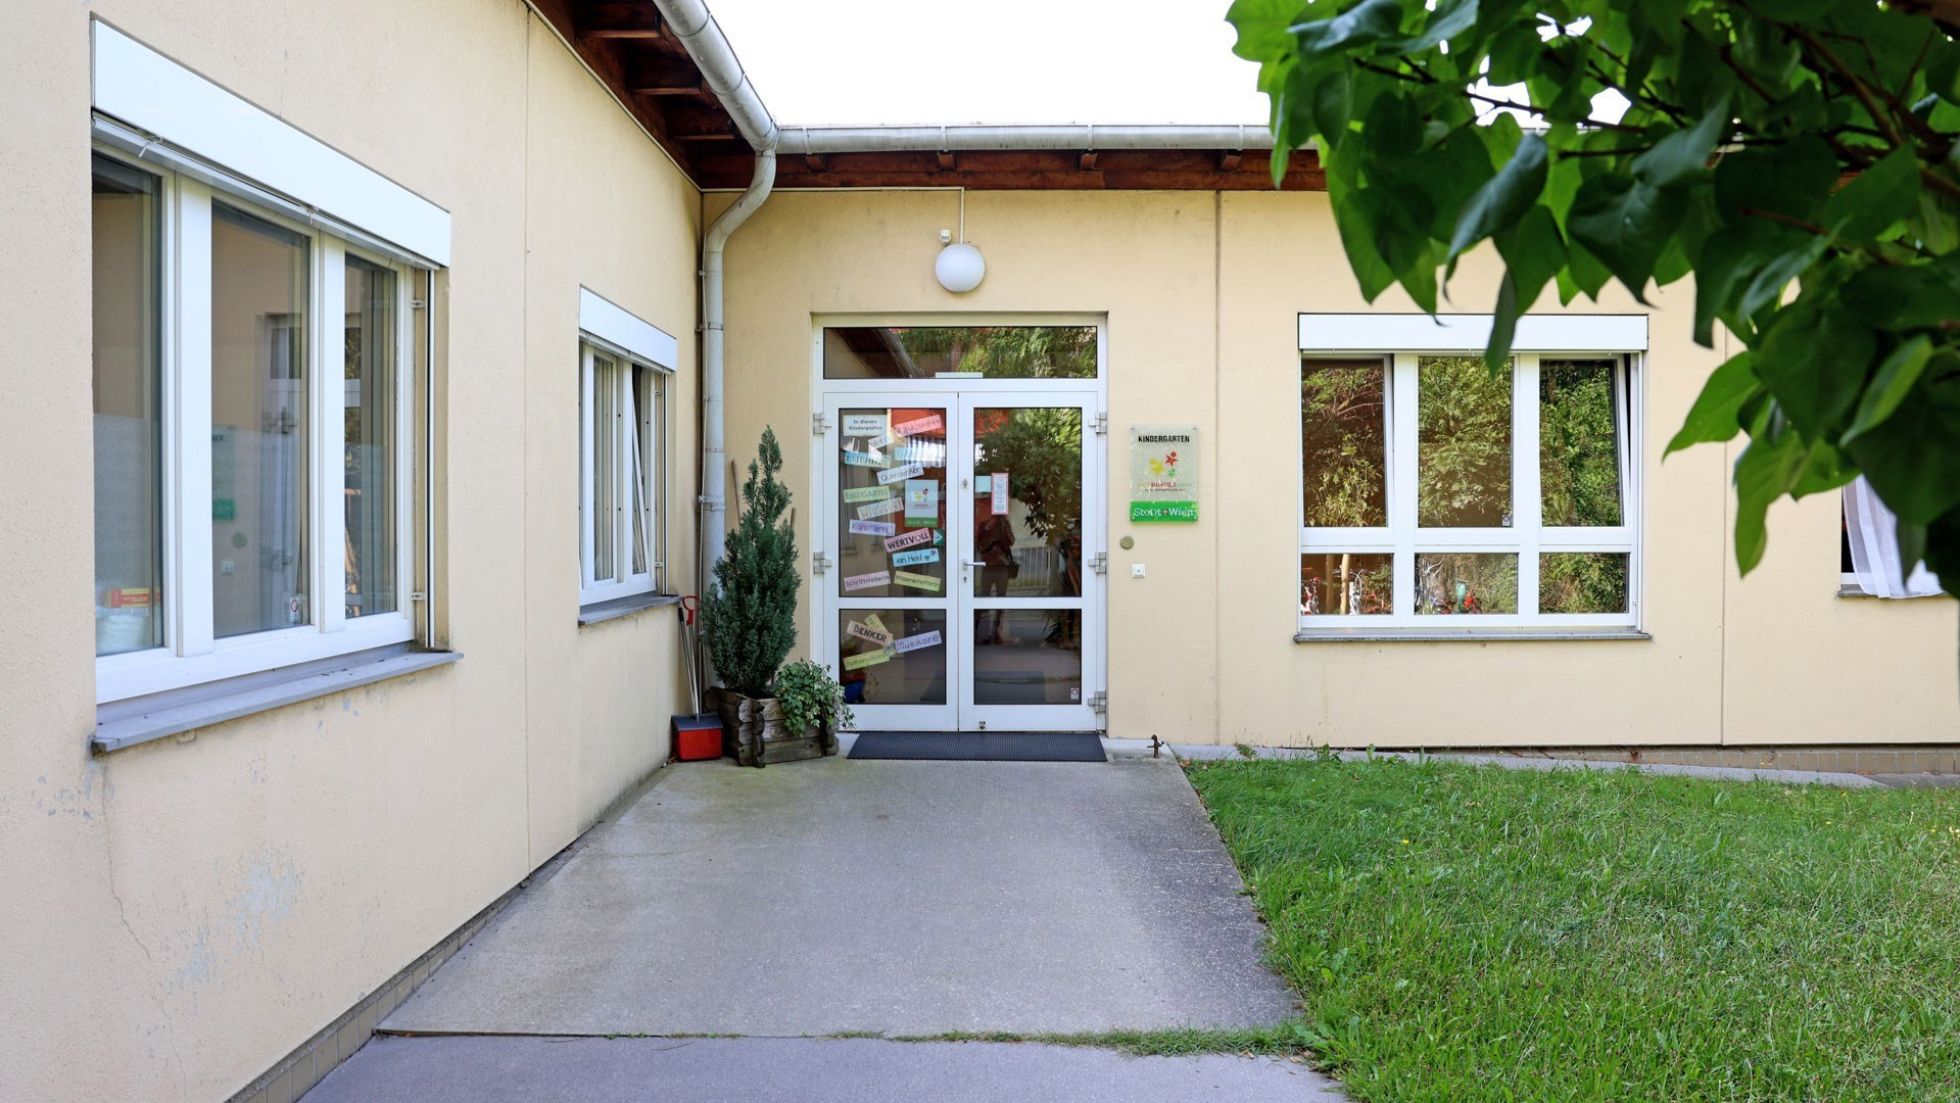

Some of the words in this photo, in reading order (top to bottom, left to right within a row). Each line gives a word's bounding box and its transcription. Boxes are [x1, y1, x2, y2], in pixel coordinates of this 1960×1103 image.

[1138, 435, 1190, 443] KINDERGARTEN
[887, 531, 928, 550] WERTVOLL
[907, 554, 922, 562] Held
[854, 623, 887, 643] DENKER
